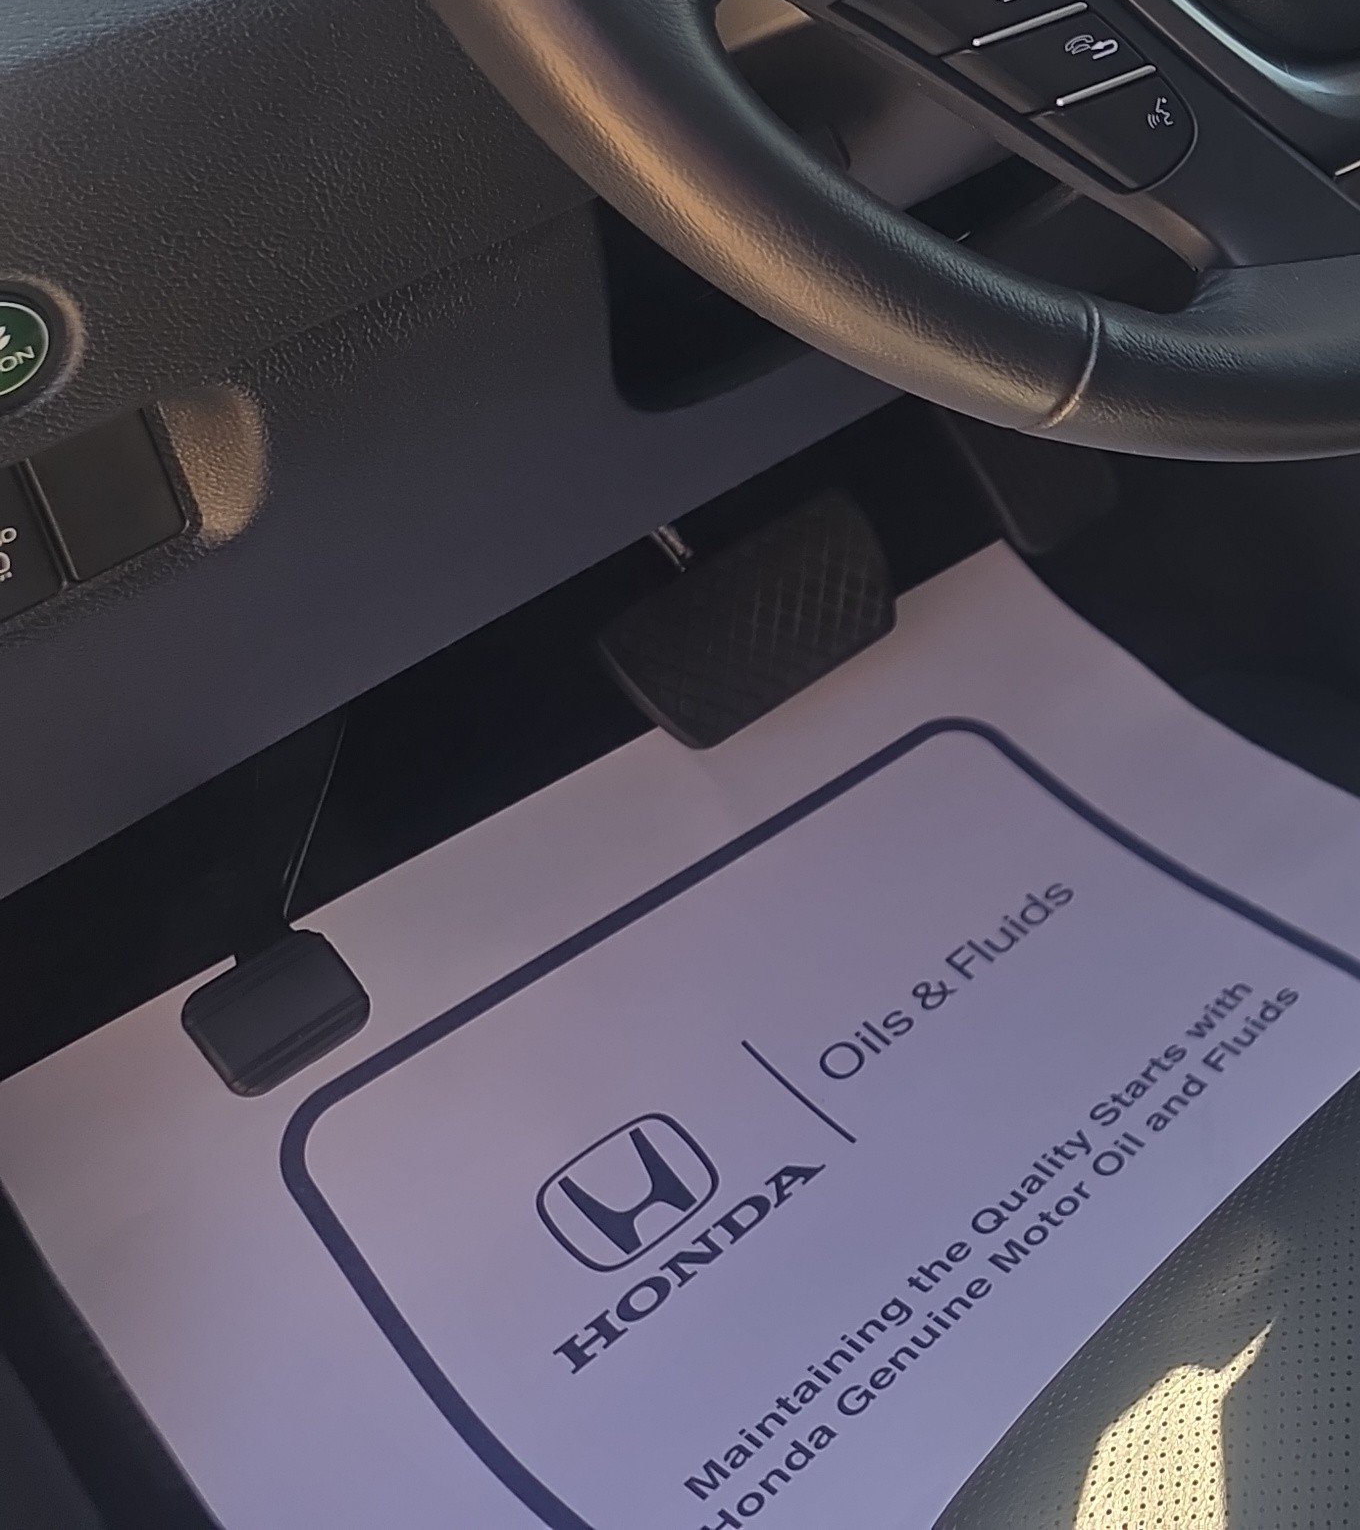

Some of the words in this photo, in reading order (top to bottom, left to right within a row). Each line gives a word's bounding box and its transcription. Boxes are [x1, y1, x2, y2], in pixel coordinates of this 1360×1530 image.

[0, 345, 36, 373] ON
[818, 1009, 915, 1080] Oils
[911, 980, 958, 1011] &
[944, 882, 1075, 981] Fluids
[552, 1163, 827, 1375] HONDA
[683, 1296, 914, 1501] Maintaining
[907, 1240, 973, 1294] the
[970, 1128, 1094, 1236] Quality
[1088, 1043, 1188, 1127] Starts
[1185, 979, 1254, 1041] with
[700, 1423, 840, 1530] Honda
[836, 1276, 993, 1417] Genuine
[987, 1179, 1092, 1274] Motor
[1091, 1131, 1147, 1177] Oil
[1145, 1071, 1208, 1132] and
[1201, 984, 1300, 1073] Fluids
